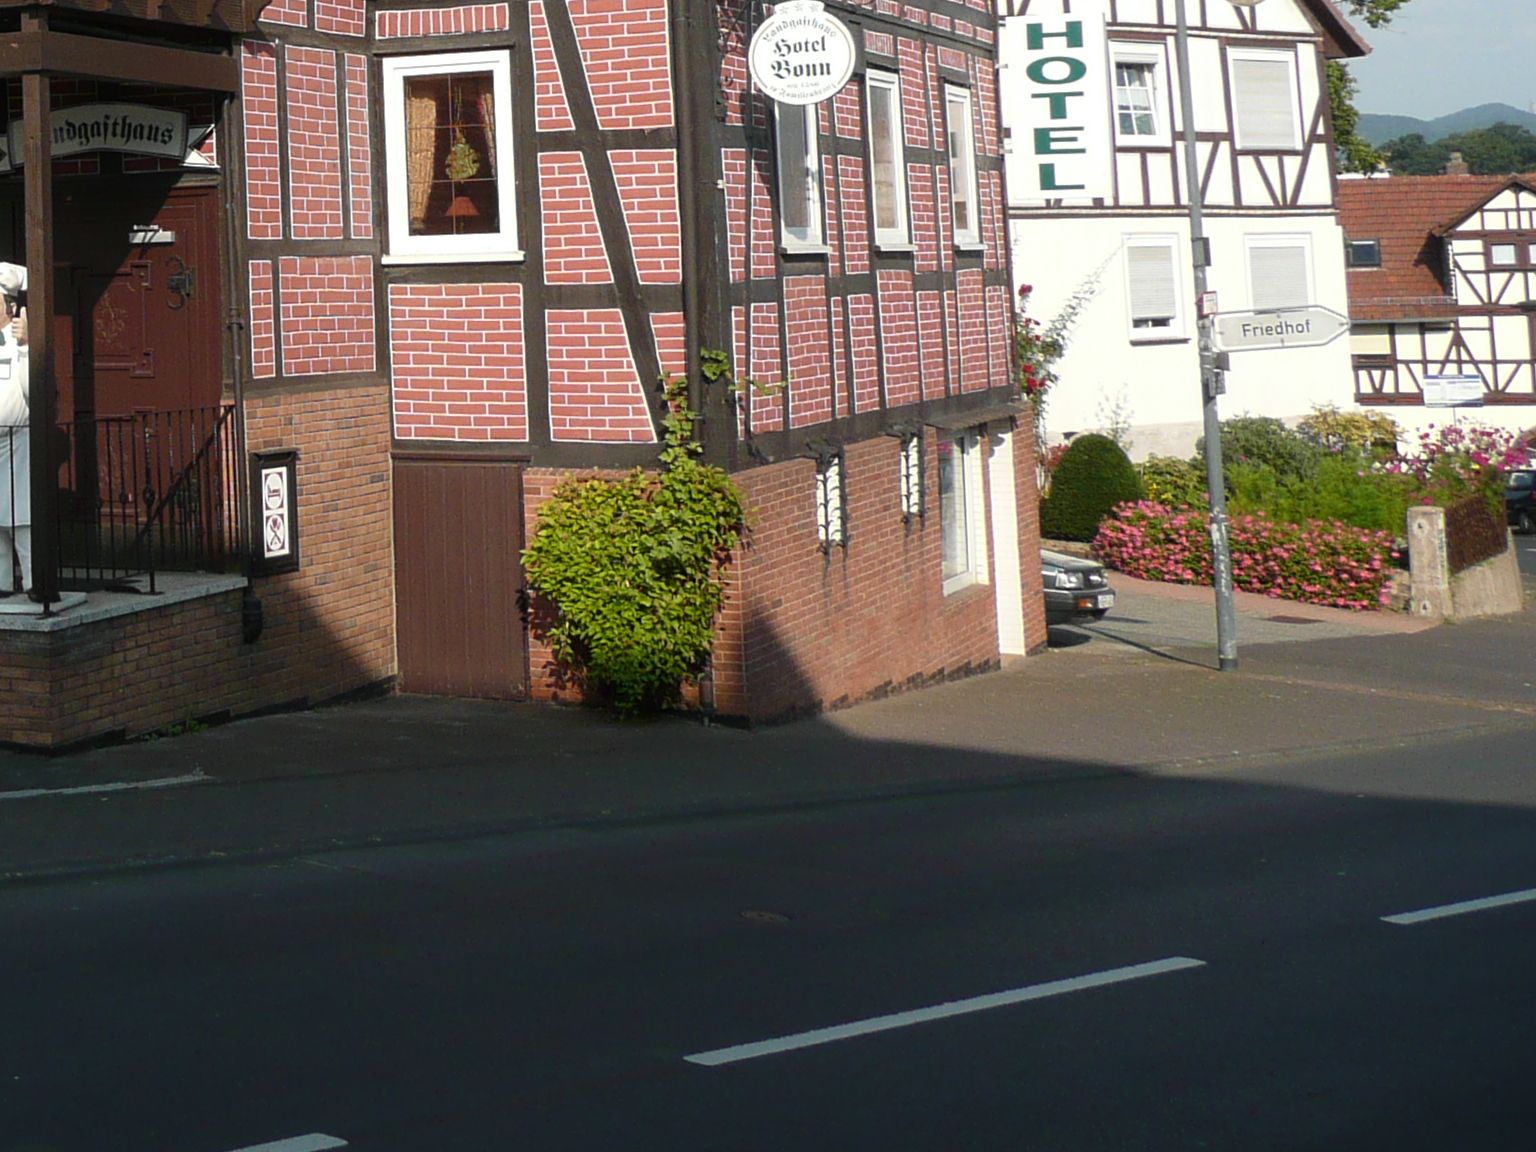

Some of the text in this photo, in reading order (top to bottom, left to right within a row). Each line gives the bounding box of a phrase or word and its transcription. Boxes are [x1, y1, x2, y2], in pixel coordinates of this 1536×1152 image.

[773, 35, 826, 57] Hotel
[771, 59, 831, 79] Bonn
[1026, 21, 1087, 190] HOTEL
[53, 114, 174, 145] ndgasthaus
[1242, 319, 1311, 337] Friedhof
